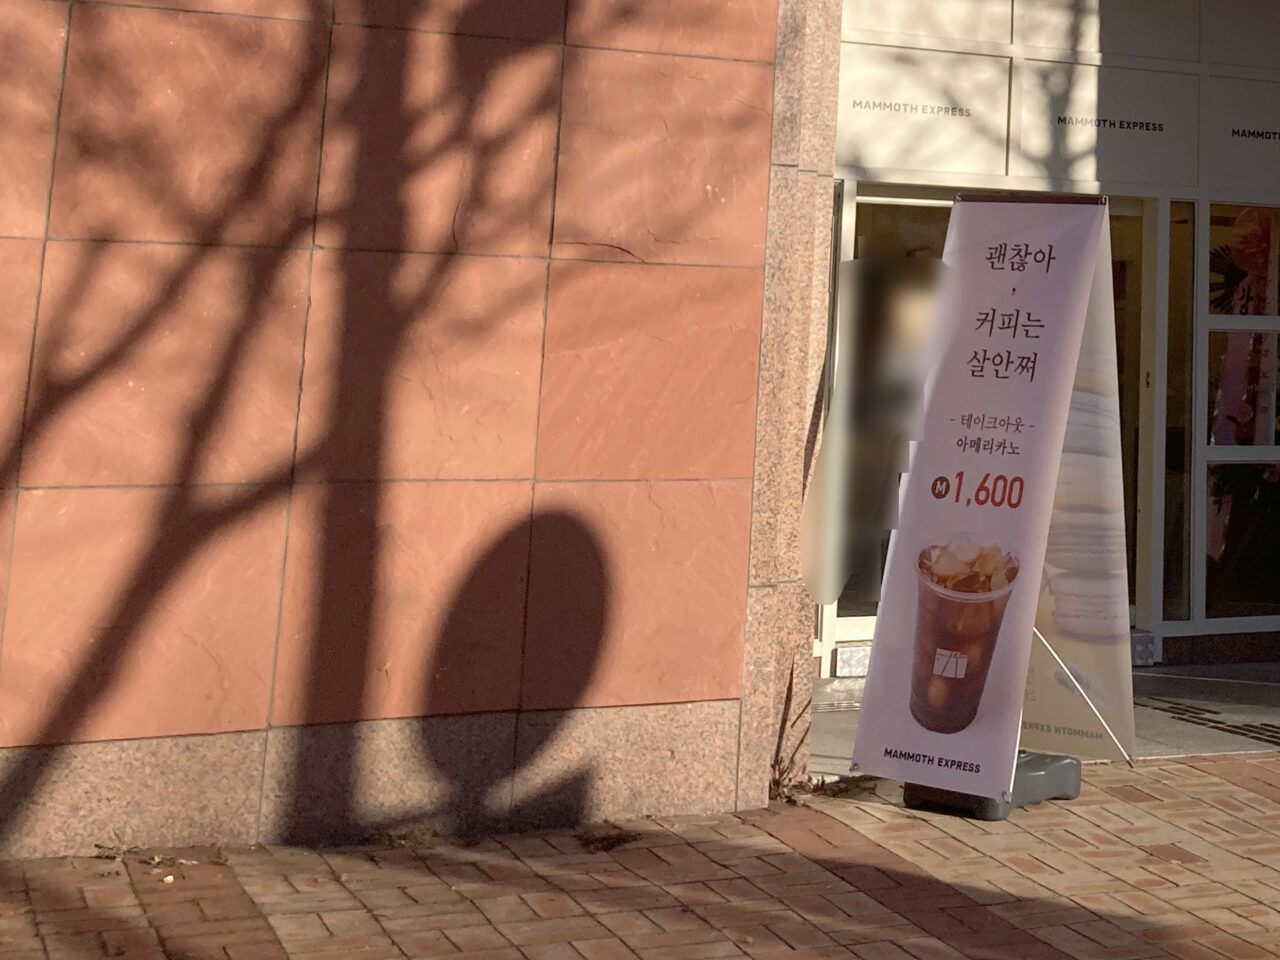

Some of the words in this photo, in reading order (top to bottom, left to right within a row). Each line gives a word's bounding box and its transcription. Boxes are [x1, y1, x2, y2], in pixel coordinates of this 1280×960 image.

[853, 99, 918, 116] MAMMOTH
[922, 104, 971, 118] EXPRESS
[1057, 115, 1115, 131] MAMMOTH
[1118, 120, 1164, 133] EXPRESS
[984, 243, 1056, 273] 괜찮아
[975, 308, 1045, 339] 커피는
[956, 436, 1021, 456] 아메리카노
[953, 471, 1024, 509] 1,600
[883, 747, 934, 766] MAMMOTH
[937, 755, 981, 774] EXPRESS
